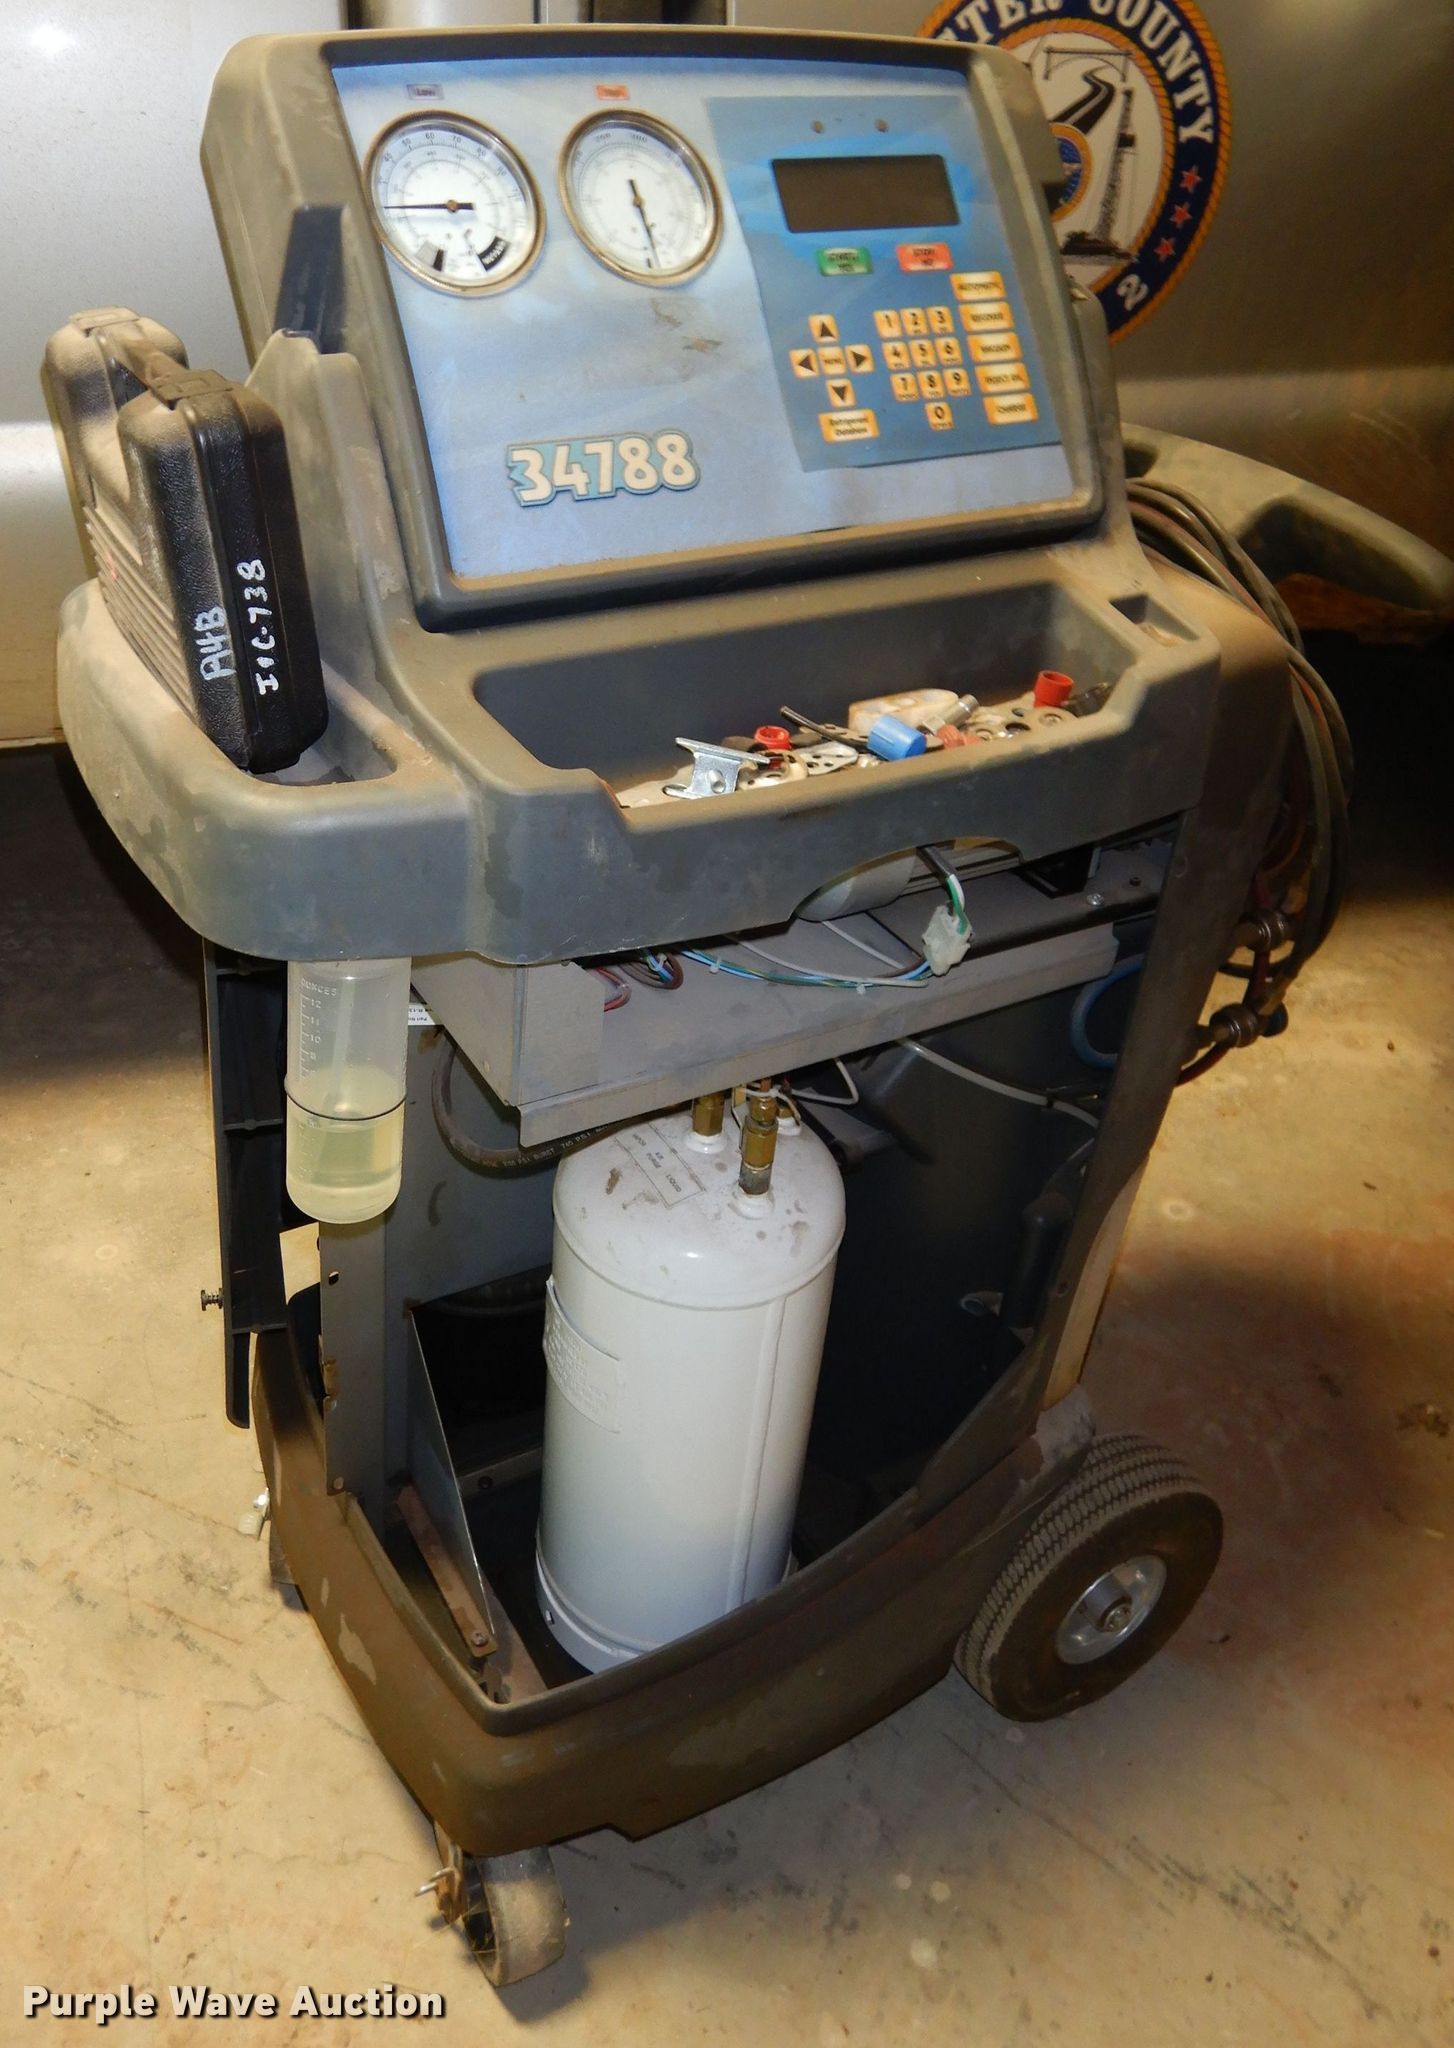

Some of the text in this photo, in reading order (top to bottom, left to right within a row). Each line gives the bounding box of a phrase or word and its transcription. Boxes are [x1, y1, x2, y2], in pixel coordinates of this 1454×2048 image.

[884, 314, 893, 329] 1
[911, 312, 920, 326] 2
[936, 310, 946, 324] 3
[892, 345, 901, 358] 4
[918, 343, 927, 357] 5
[944, 341, 954, 355] 6
[900, 376, 909, 391] 7
[927, 374, 937, 388] 8
[952, 372, 962, 386] 9
[934, 405, 945, 420] 0
[509, 432, 699, 504] 34788
[301, 978, 337, 996] OUNCES
[311, 999, 321, 1009] 12
[310, 1033, 321, 1044] 10
[666, 1174, 682, 1193] LIQUID
